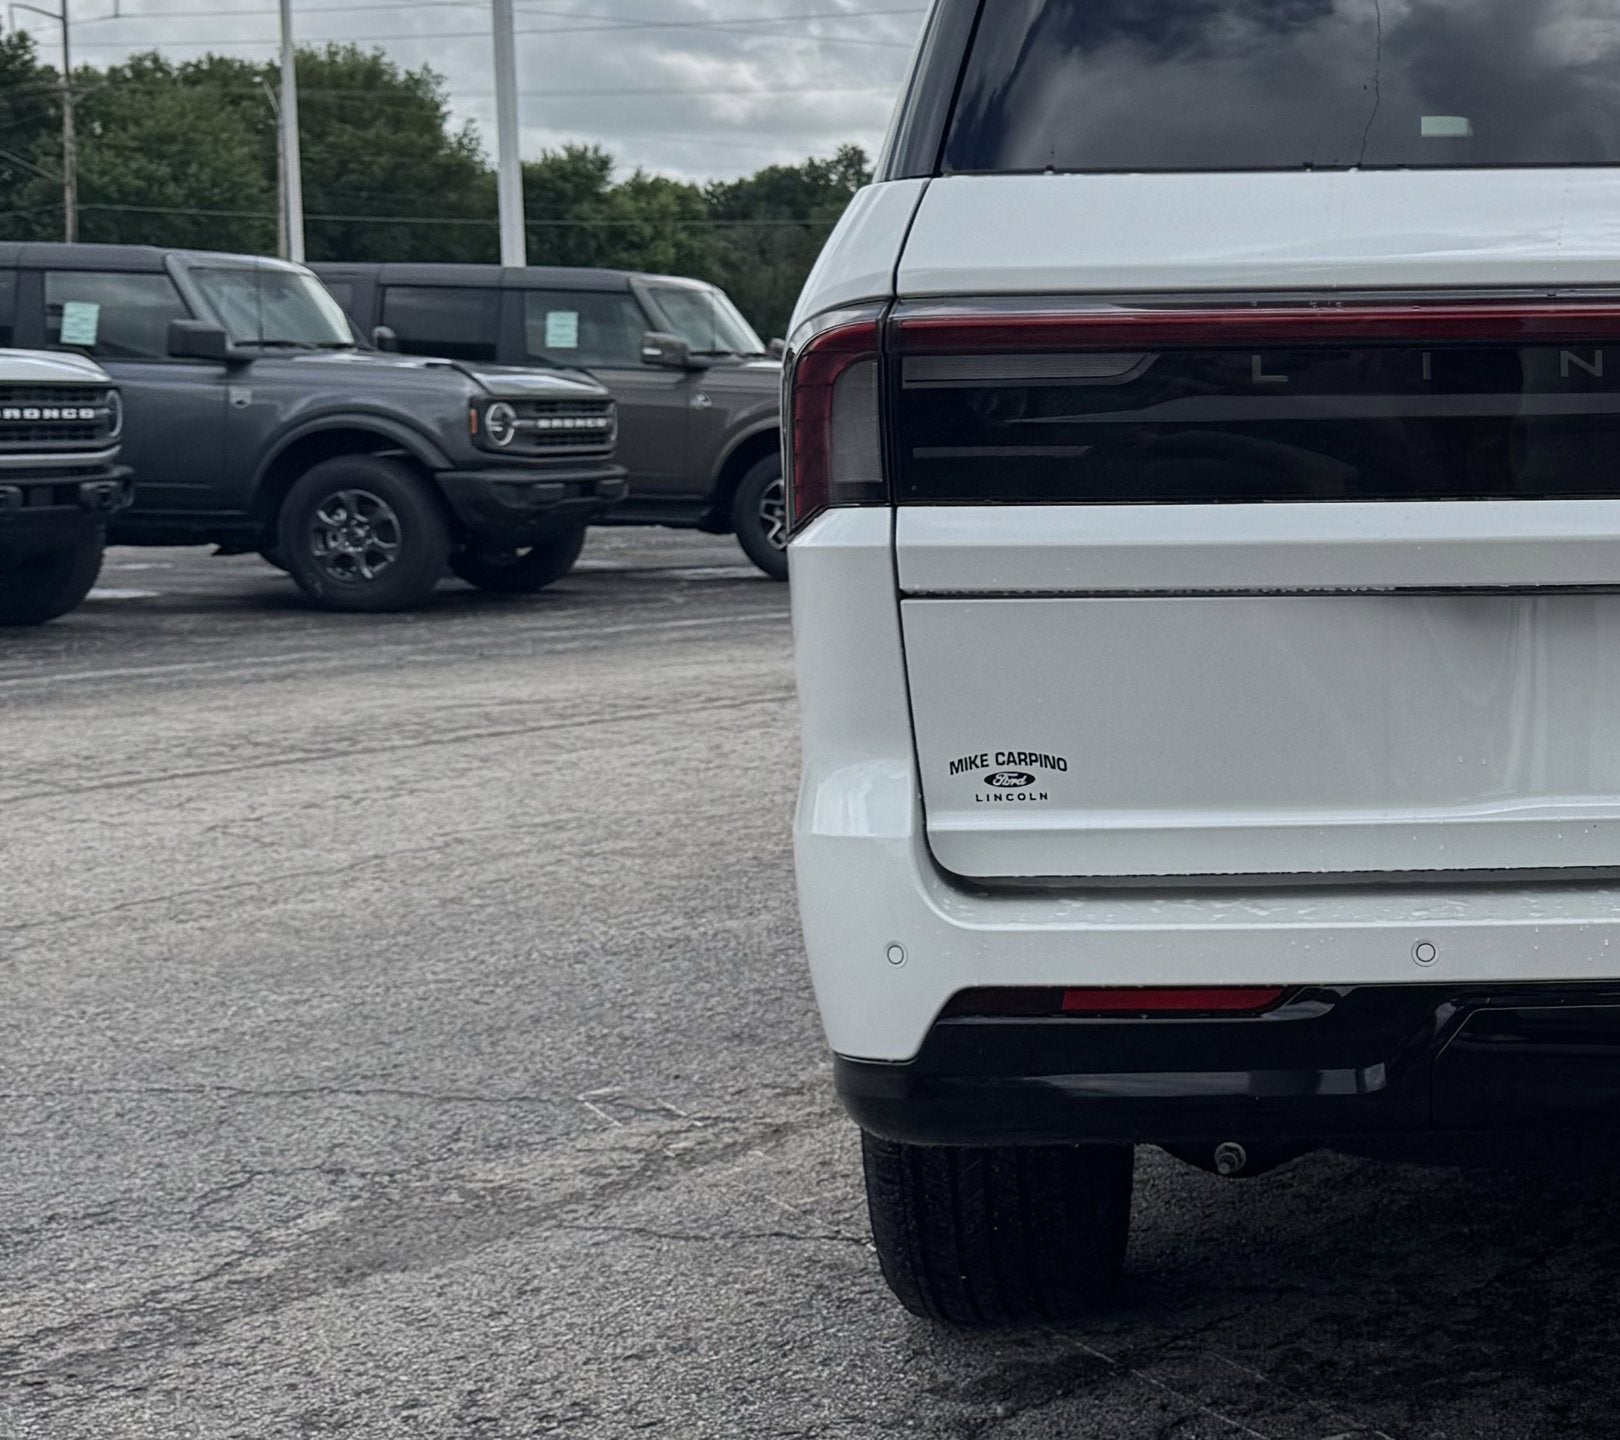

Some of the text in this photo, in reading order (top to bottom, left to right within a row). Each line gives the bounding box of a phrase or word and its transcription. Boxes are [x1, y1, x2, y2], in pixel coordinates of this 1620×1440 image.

[0, 408, 95, 420] RONCO
[949, 751, 1068, 776] MIKE CARPINO
[990, 772, 1030, 788] Ford
[975, 792, 1048, 802] LINCOLN
